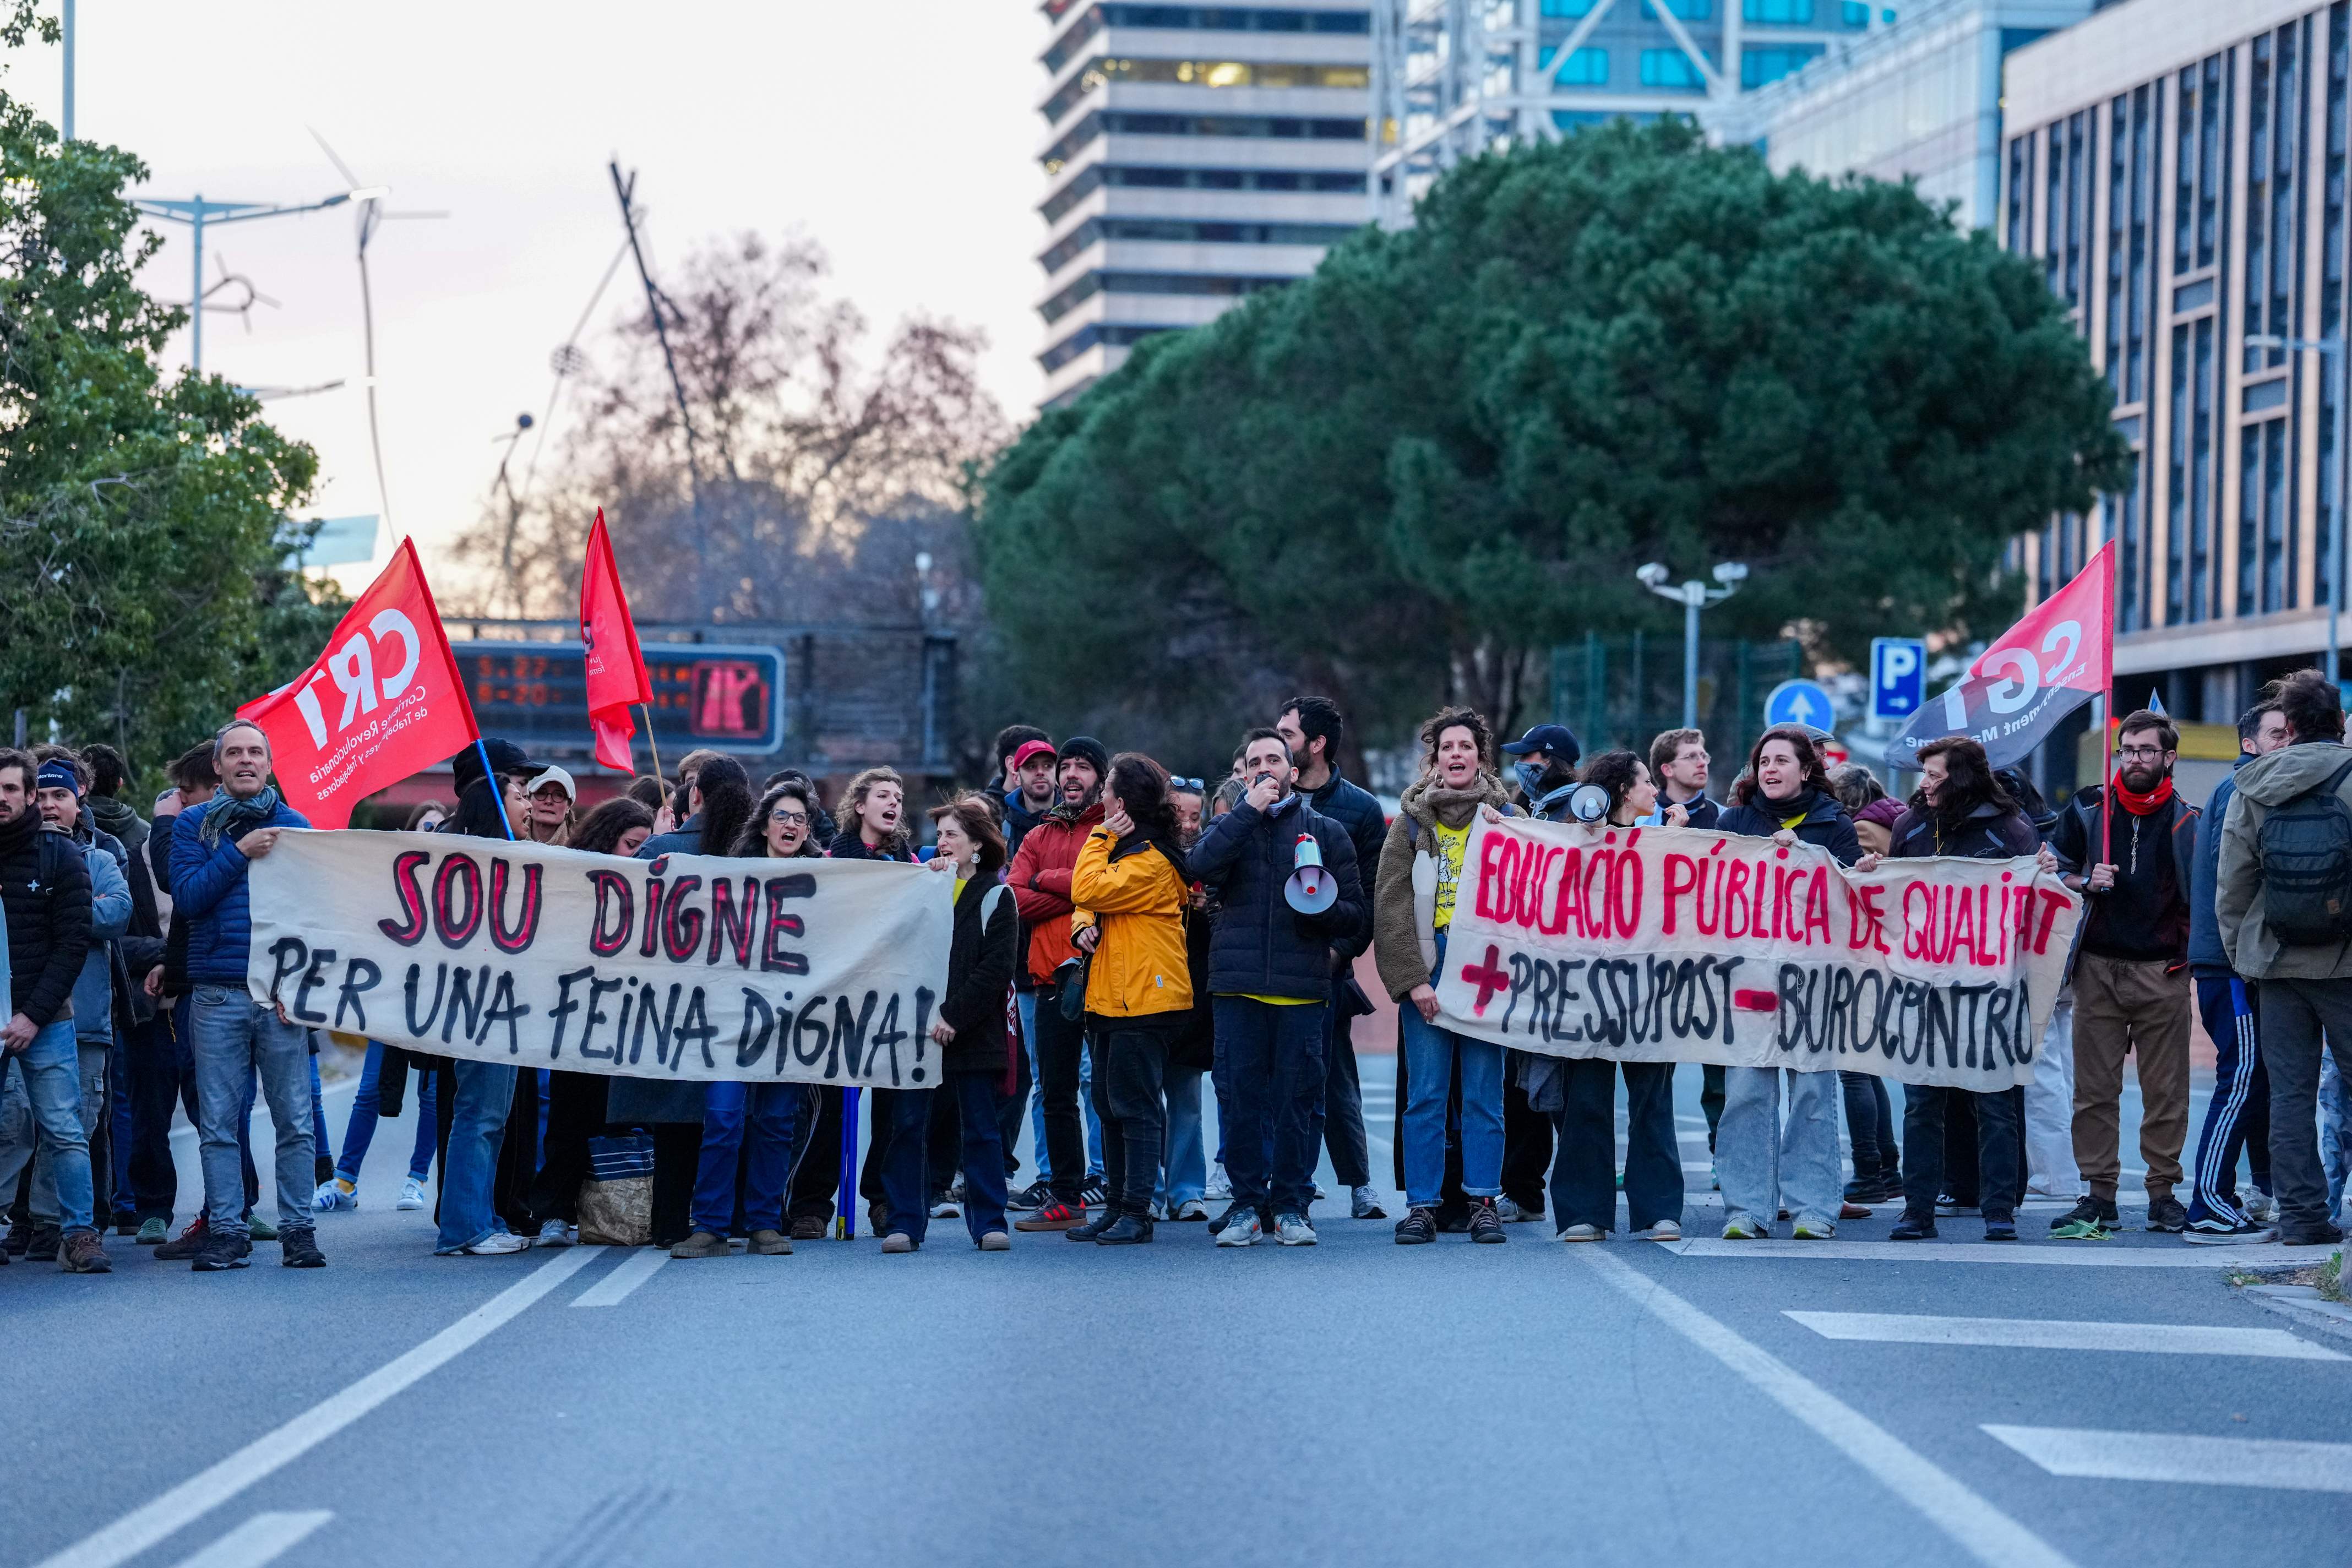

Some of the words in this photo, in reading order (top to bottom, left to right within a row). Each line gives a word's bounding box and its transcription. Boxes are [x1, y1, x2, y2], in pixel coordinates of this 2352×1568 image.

[1882, 646, 1917, 689] P
[377, 851, 544, 955] SOU
[1848, 885, 1890, 955] DE
[268, 937, 382, 1032] PER
[404, 962, 530, 1055] UNA
